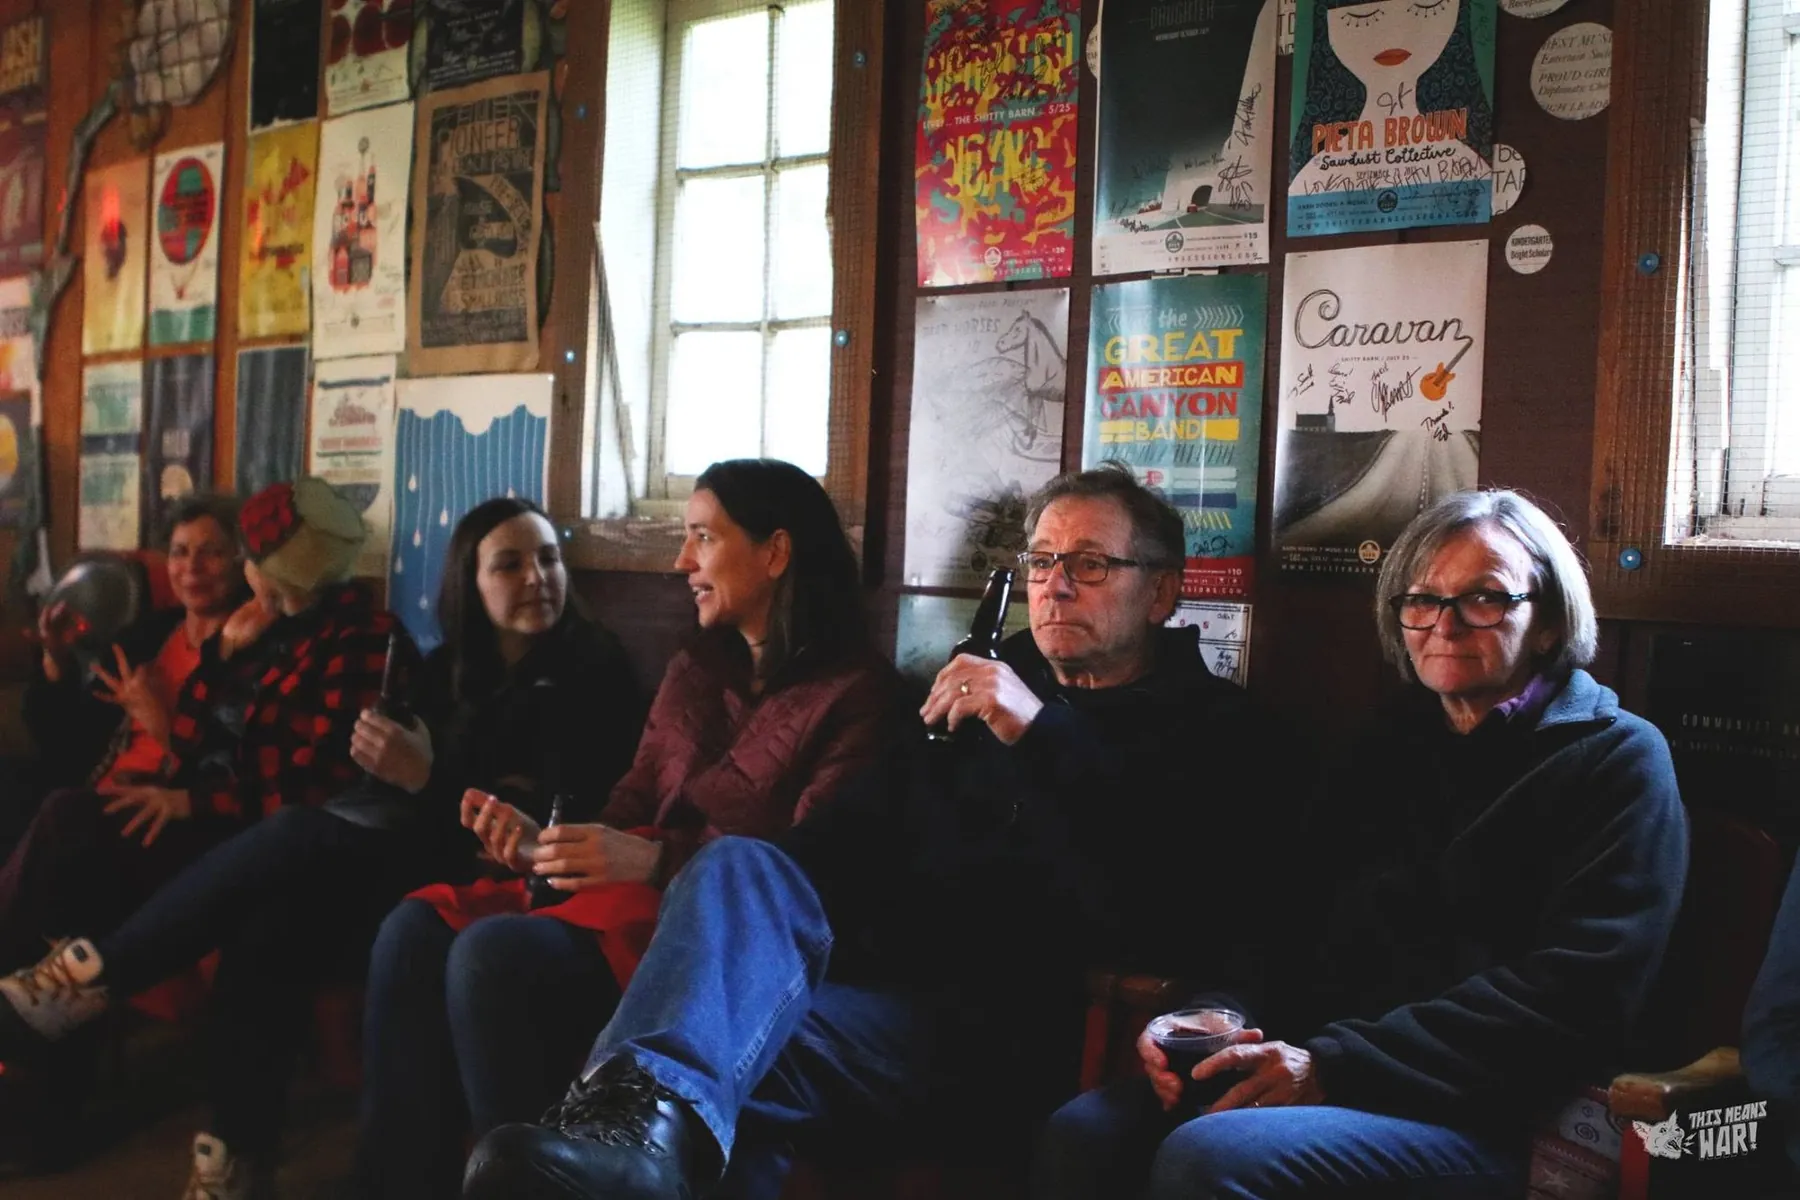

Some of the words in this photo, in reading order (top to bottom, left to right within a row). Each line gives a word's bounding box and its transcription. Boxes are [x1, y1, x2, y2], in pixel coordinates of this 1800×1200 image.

[955, 115, 971, 125] THE
[974, 111, 1005, 123] SHITTY
[1008, 107, 1035, 119] BARN
[1048, 103, 1072, 113] 5/25
[1312, 121, 1374, 155] PIETA
[1385, 109, 1468, 147] BROWN
[1320, 151, 1381, 170] Sawdust
[1386, 145, 1457, 164] Collective
[1158, 308, 1187, 328] the
[1294, 289, 1472, 349] Caravan
[1104, 328, 1243, 364] GREAT
[1102, 365, 1237, 390] AMERICAN
[1101, 392, 1237, 419] CANYON
[1135, 419, 1201, 441] BAND
[1227, 568, 1242, 576] $10
